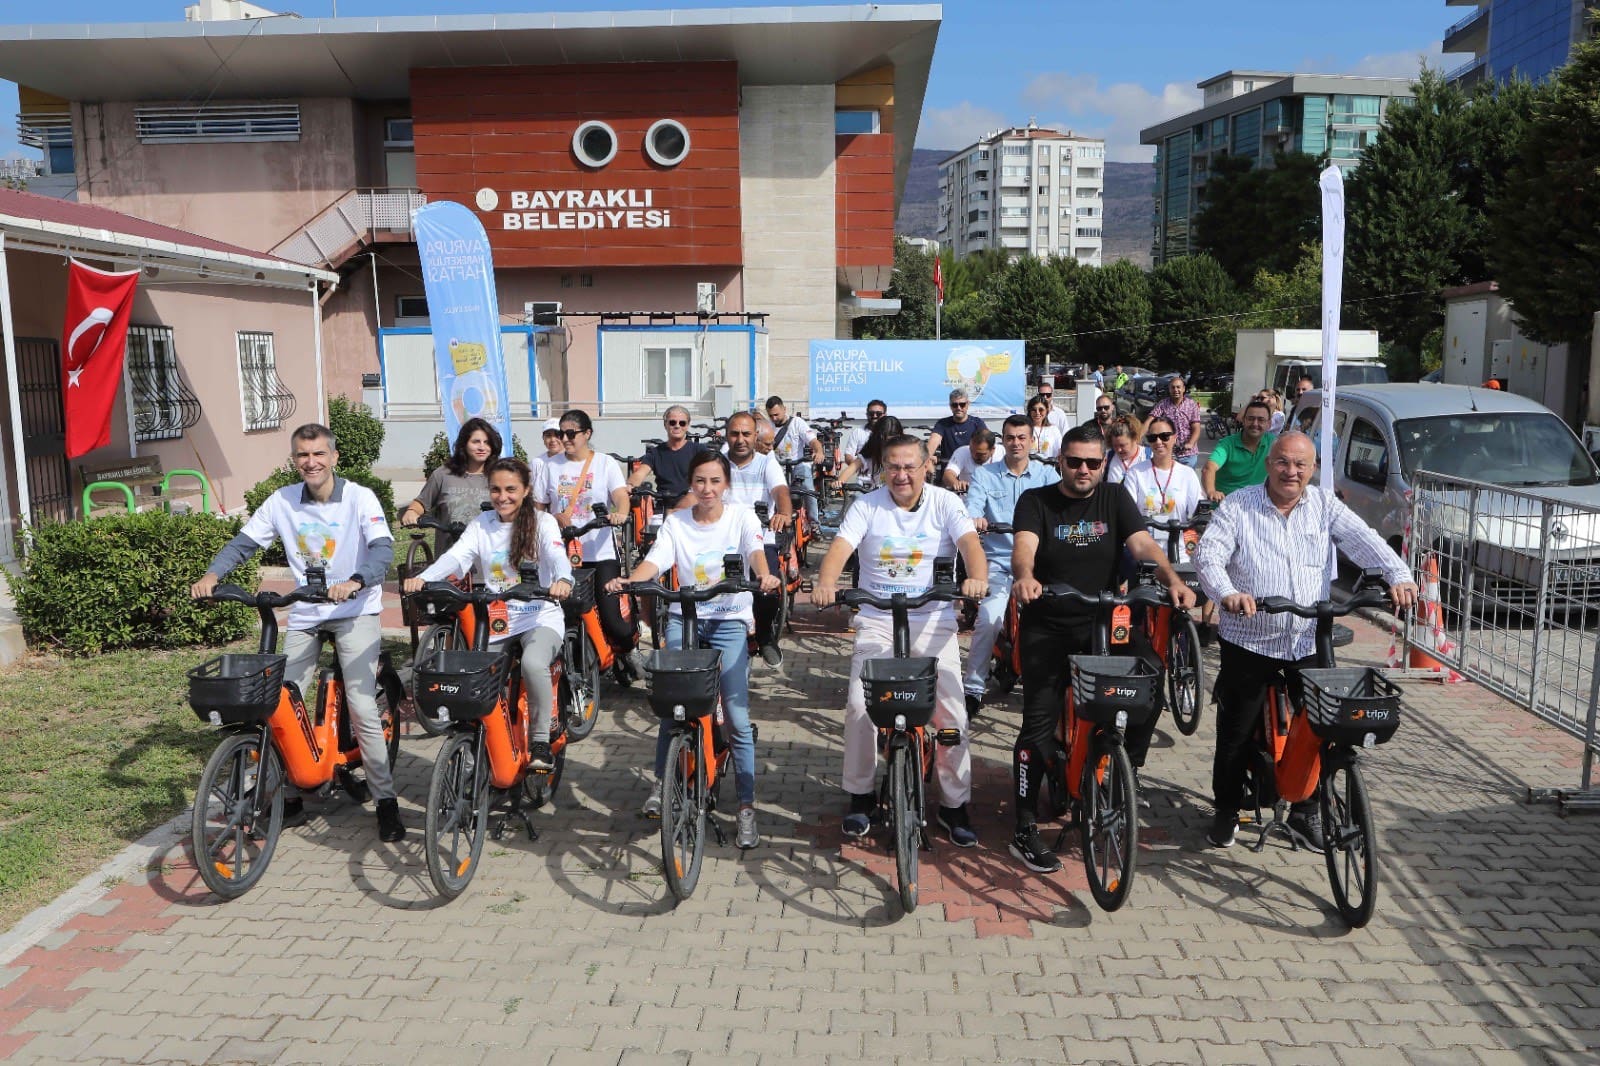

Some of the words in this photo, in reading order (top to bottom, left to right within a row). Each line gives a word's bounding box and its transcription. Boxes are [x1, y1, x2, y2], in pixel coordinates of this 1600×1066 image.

[511, 189, 652, 209] BAYRAKLI
[816, 349, 868, 361] AVRUPA
[816, 372, 867, 385] HAFTASI
[440, 683, 460, 694] tripy
[1116, 687, 1137, 697] tripy
[893, 690, 917, 701] tripy
[1366, 708, 1390, 720] tripy
[1019, 762, 1029, 798] lotto
